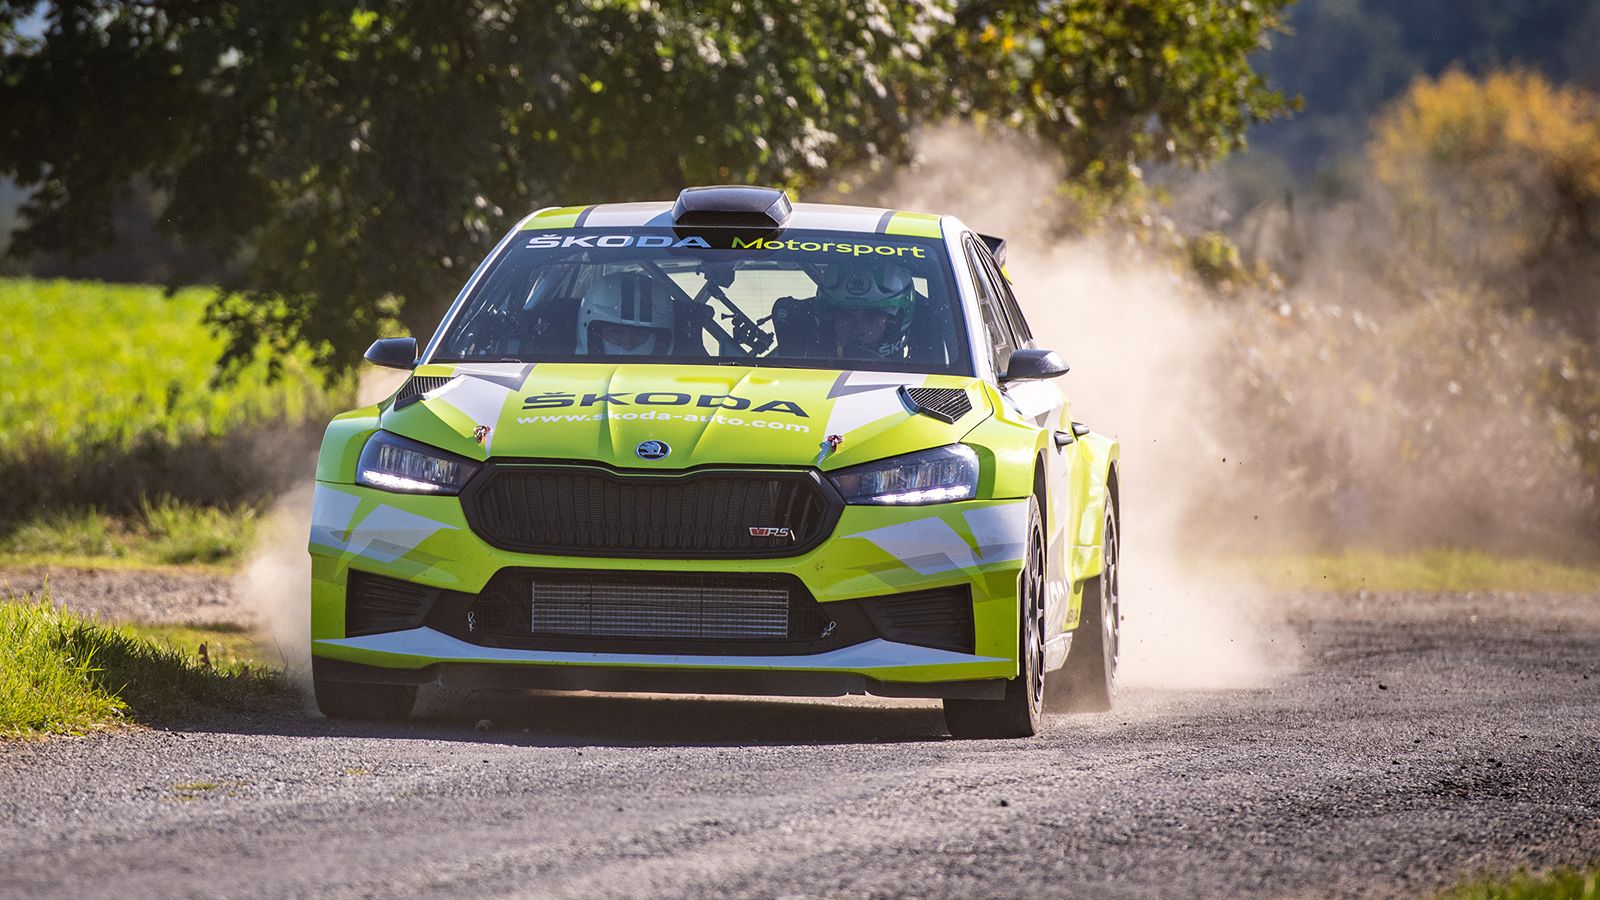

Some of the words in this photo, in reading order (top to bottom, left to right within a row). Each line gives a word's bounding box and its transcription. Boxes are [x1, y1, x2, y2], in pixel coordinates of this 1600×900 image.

[525, 234, 711, 249] ŠKODA
[731, 237, 925, 259] Motorsport
[523, 391, 809, 418] ŠKODA
[517, 411, 810, 433] www.skoda-auto.com
